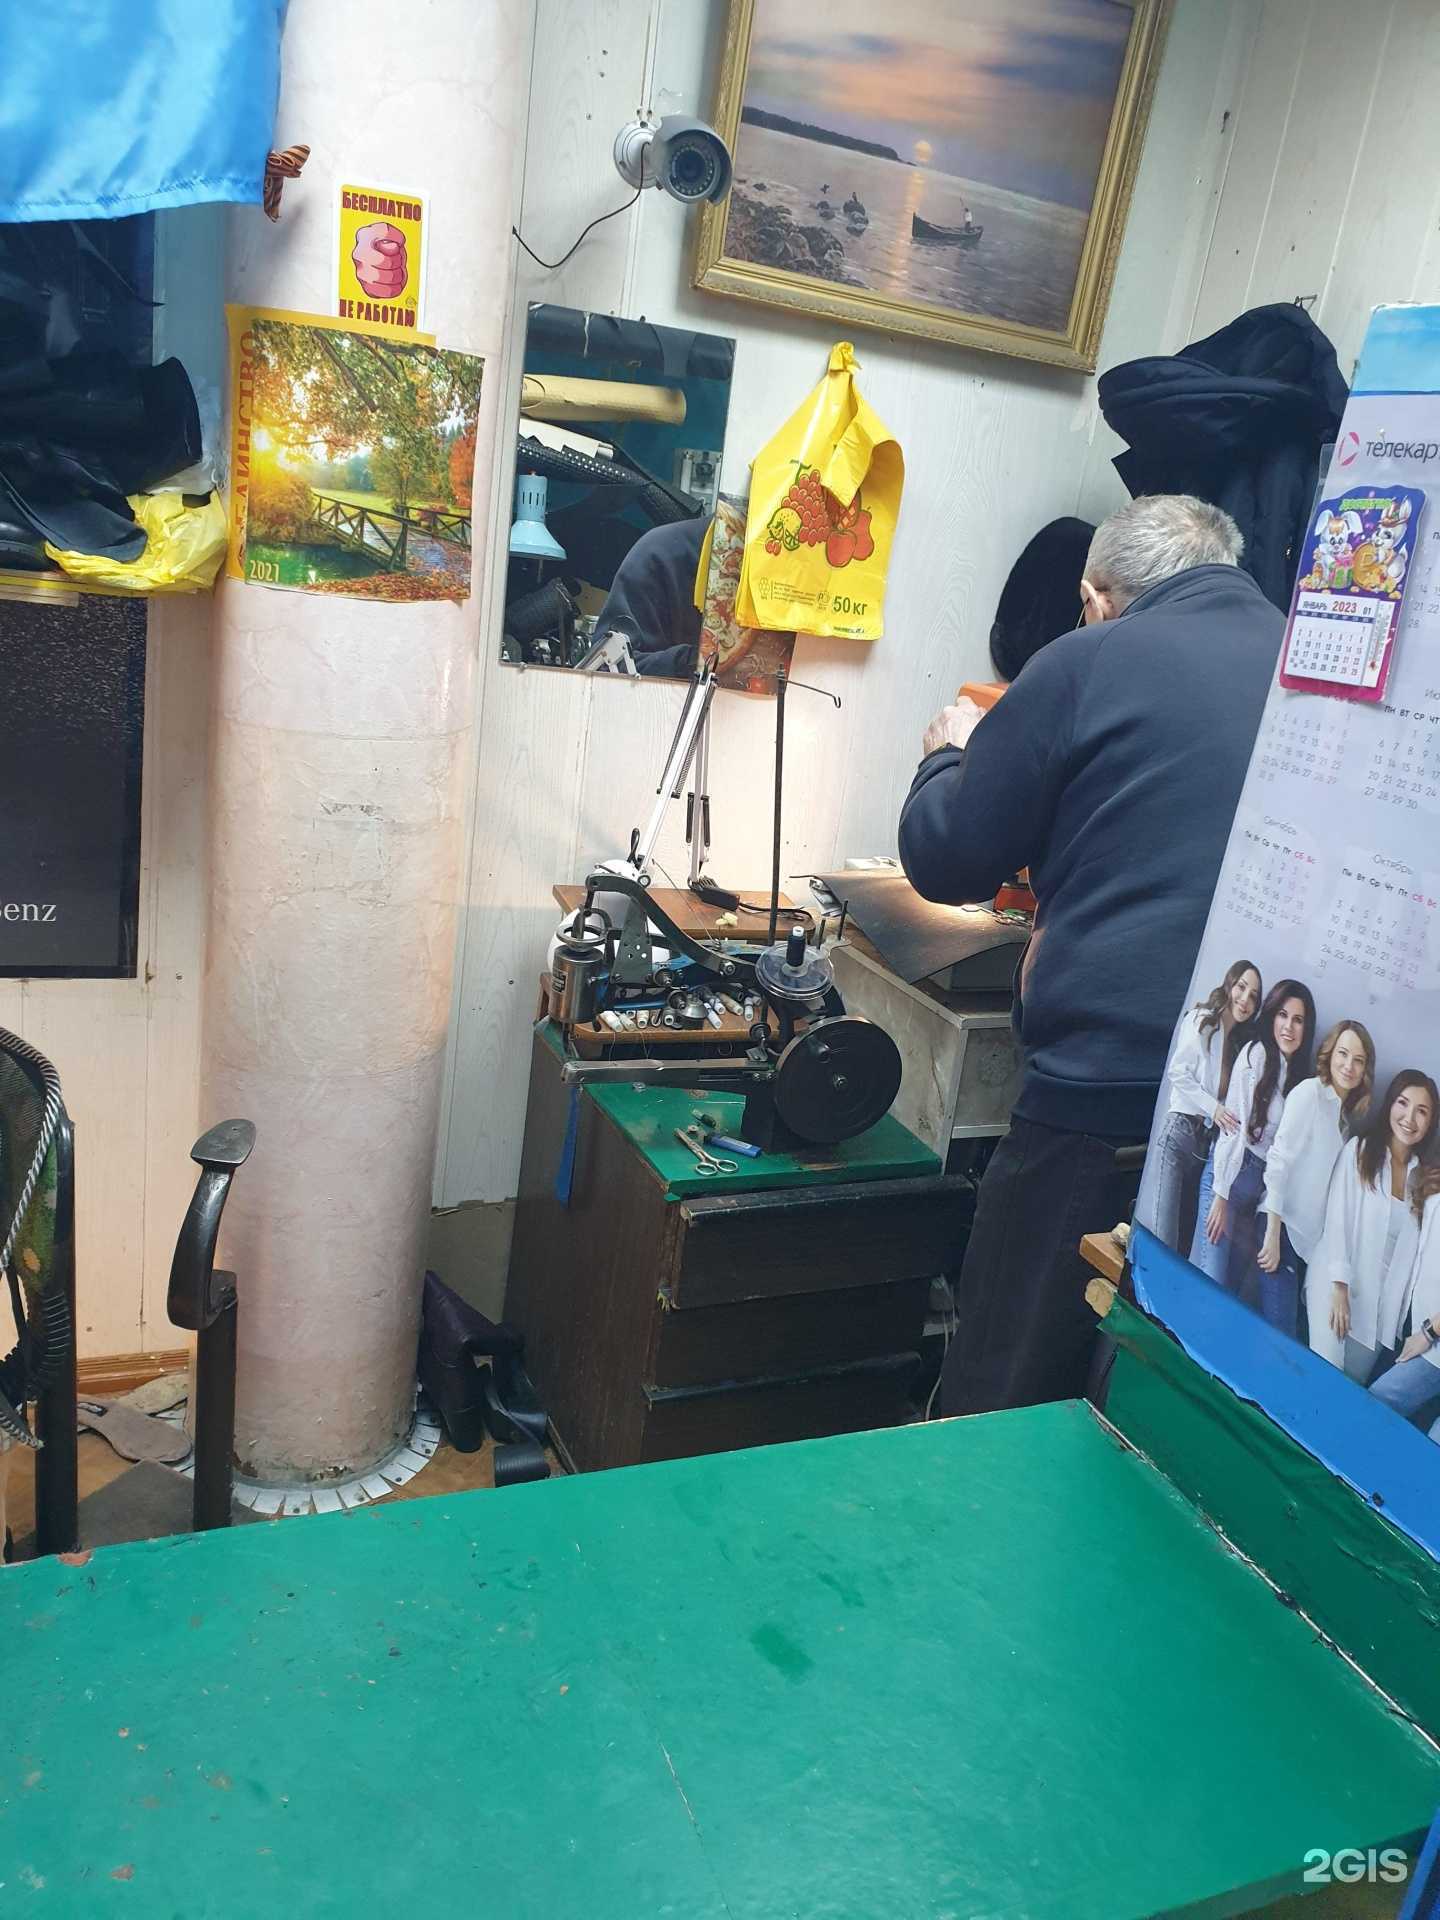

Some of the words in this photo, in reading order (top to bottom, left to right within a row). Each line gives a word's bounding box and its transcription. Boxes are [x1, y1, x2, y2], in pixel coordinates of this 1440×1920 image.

[342, 191, 423, 221] БЕСПЛАТНО
[339, 298, 354, 319] НЕ
[356, 301, 416, 328] РАБОТАЮ
[1366, 441, 1440, 463] телекар
[250, 559, 280, 581] 2021
[832, 595, 851, 614] 50
[853, 601, 868, 616] кг
[1332, 601, 1357, 613] 2023
[0, 903, 57, 922] enz
